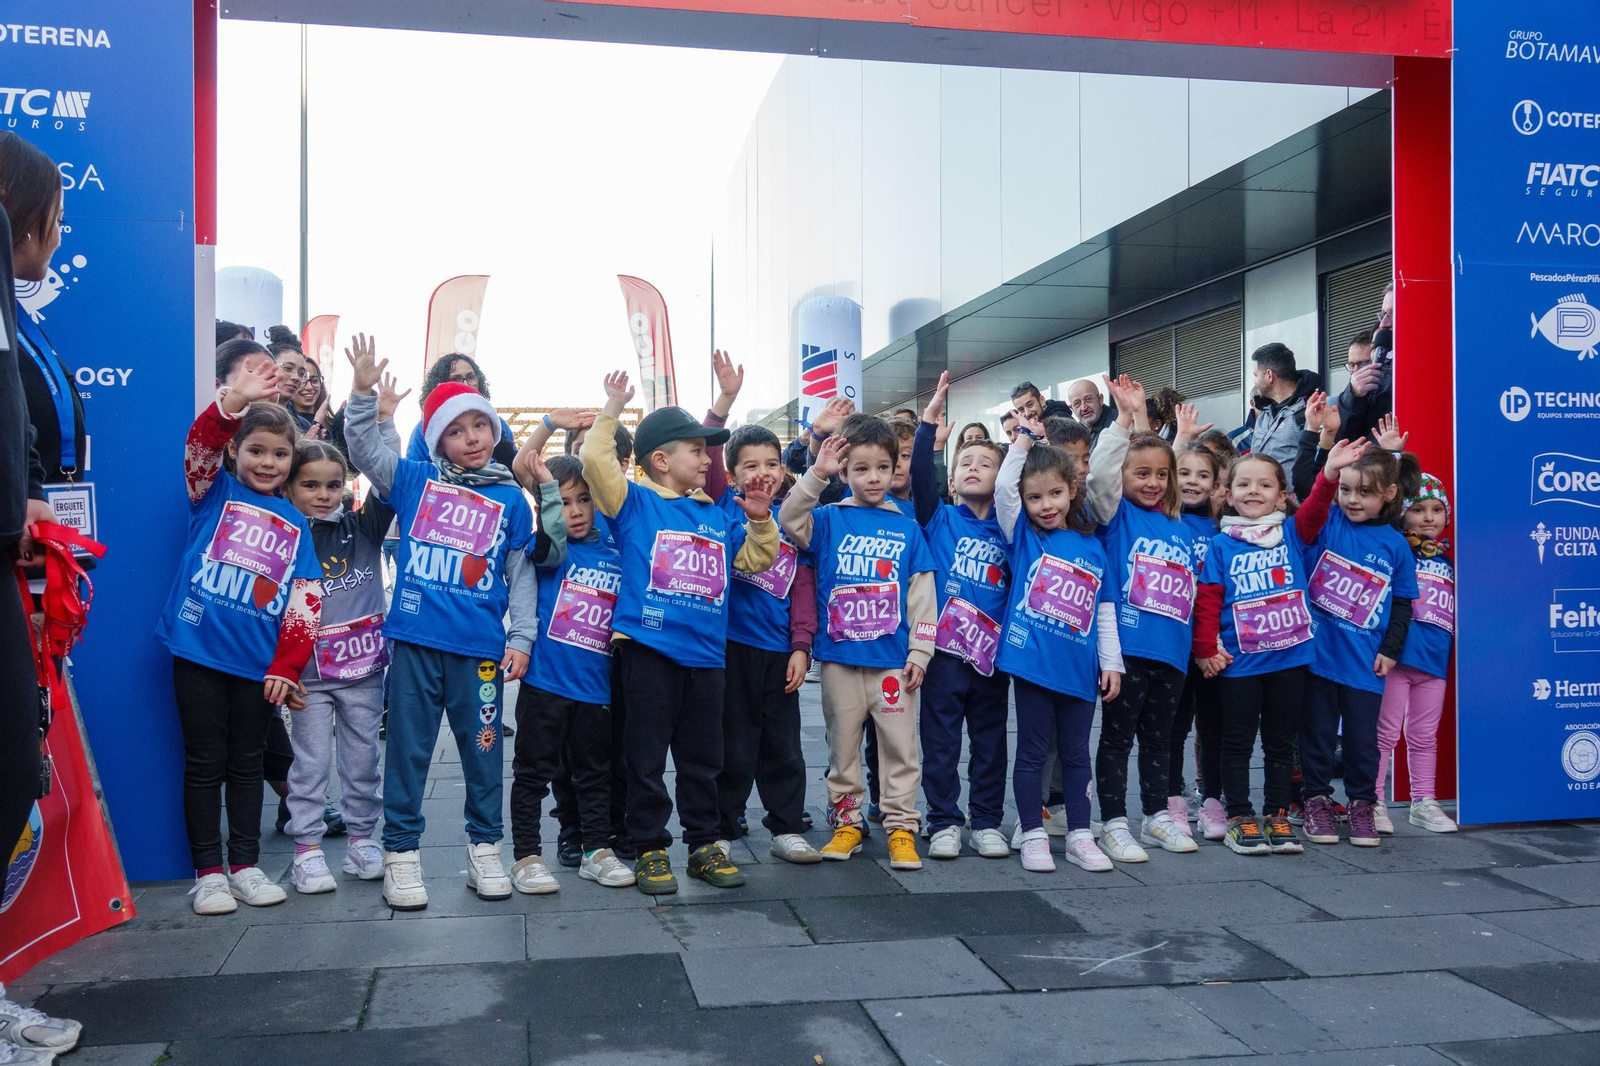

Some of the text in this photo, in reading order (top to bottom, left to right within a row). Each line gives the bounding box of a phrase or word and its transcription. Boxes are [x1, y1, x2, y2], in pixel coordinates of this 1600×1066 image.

[1108, 0, 1188, 32] Vigo
[1296, 1, 1336, 35] La
[1352, 4, 1386, 37] 21
[1509, 29, 1543, 41] GRUPO
[1526, 162, 1600, 187] FIATC
[60, 517, 82, 527] CORRE
[437, 501, 487, 533] 2011
[228, 520, 288, 561] 2004
[426, 529, 474, 550] Alcampo
[838, 534, 906, 560] CORRER
[1554, 542, 1598, 556] CELTA
[222, 549, 272, 574] Alcampo
[673, 548, 718, 577] 2013
[1230, 544, 1290, 575] CORRER
[322, 566, 373, 597] RISAS
[428, 583, 443, 591] cara
[450, 587, 472, 597] mesma
[472, 590, 489, 600] meta
[668, 577, 712, 594] Alcampo
[1046, 575, 1095, 611] 2005
[1147, 571, 1191, 601] 2024
[1323, 571, 1373, 606] 2006
[213, 596, 229, 608] cara
[236, 604, 261, 617] mesma
[261, 612, 276, 623] meta
[653, 594, 670, 603] Anos
[671, 599, 686, 607] cara
[692, 603, 711, 612] mesma
[843, 598, 890, 622] 2012
[1143, 597, 1182, 616] Alcampo
[1316, 594, 1353, 618] Alcampo
[1426, 587, 1454, 613] 200
[573, 600, 613, 630] 202
[1041, 601, 1082, 626] Alcampo
[1254, 605, 1302, 634] 2001
[565, 629, 606, 650] Alcampo
[844, 628, 885, 638] Alcampo
[955, 616, 995, 653] 2017
[1034, 621, 1048, 632] cara
[1053, 629, 1074, 640] mesma
[1074, 635, 1088, 646] meta
[1257, 636, 1298, 649] Alcampo
[339, 662, 382, 679] Alcampo
